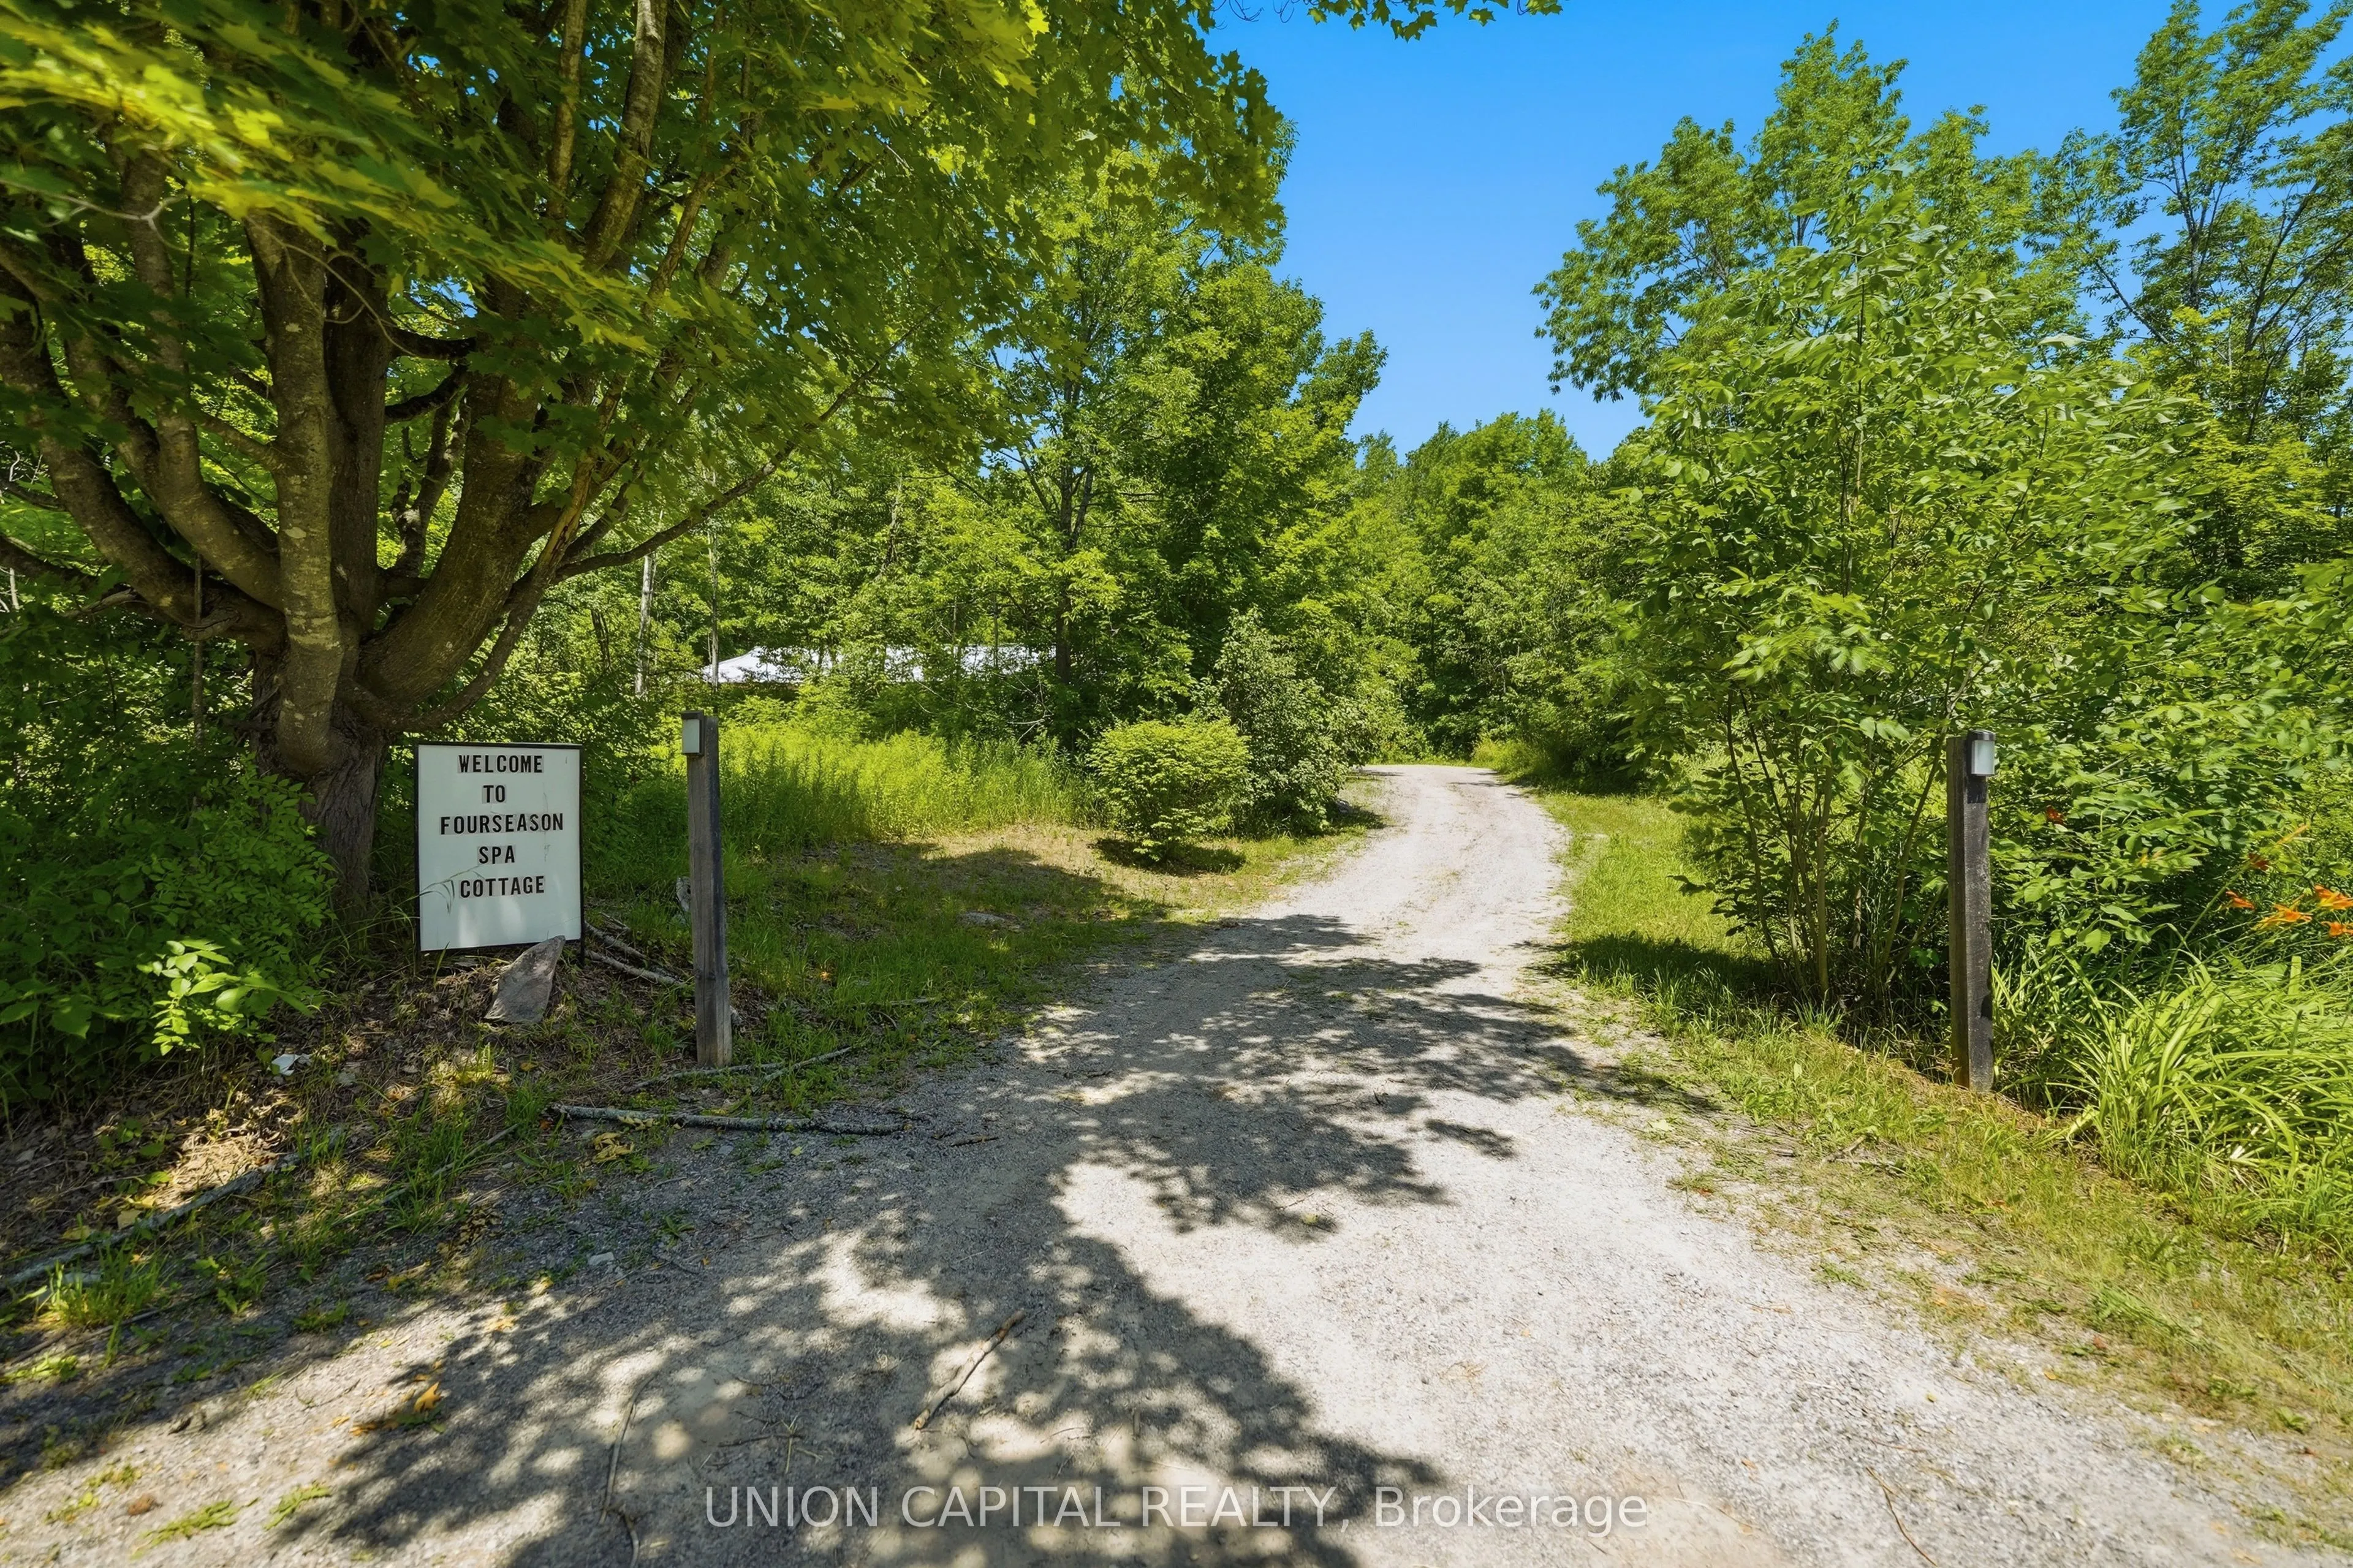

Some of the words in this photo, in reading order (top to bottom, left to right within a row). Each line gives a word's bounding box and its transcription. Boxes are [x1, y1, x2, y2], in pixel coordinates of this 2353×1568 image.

[458, 755, 543, 773] WELCOME
[483, 785, 506, 803] TO
[441, 813, 563, 835] FOURSEASON
[479, 846, 515, 865] SPA
[460, 876, 545, 898] COTTAGE
